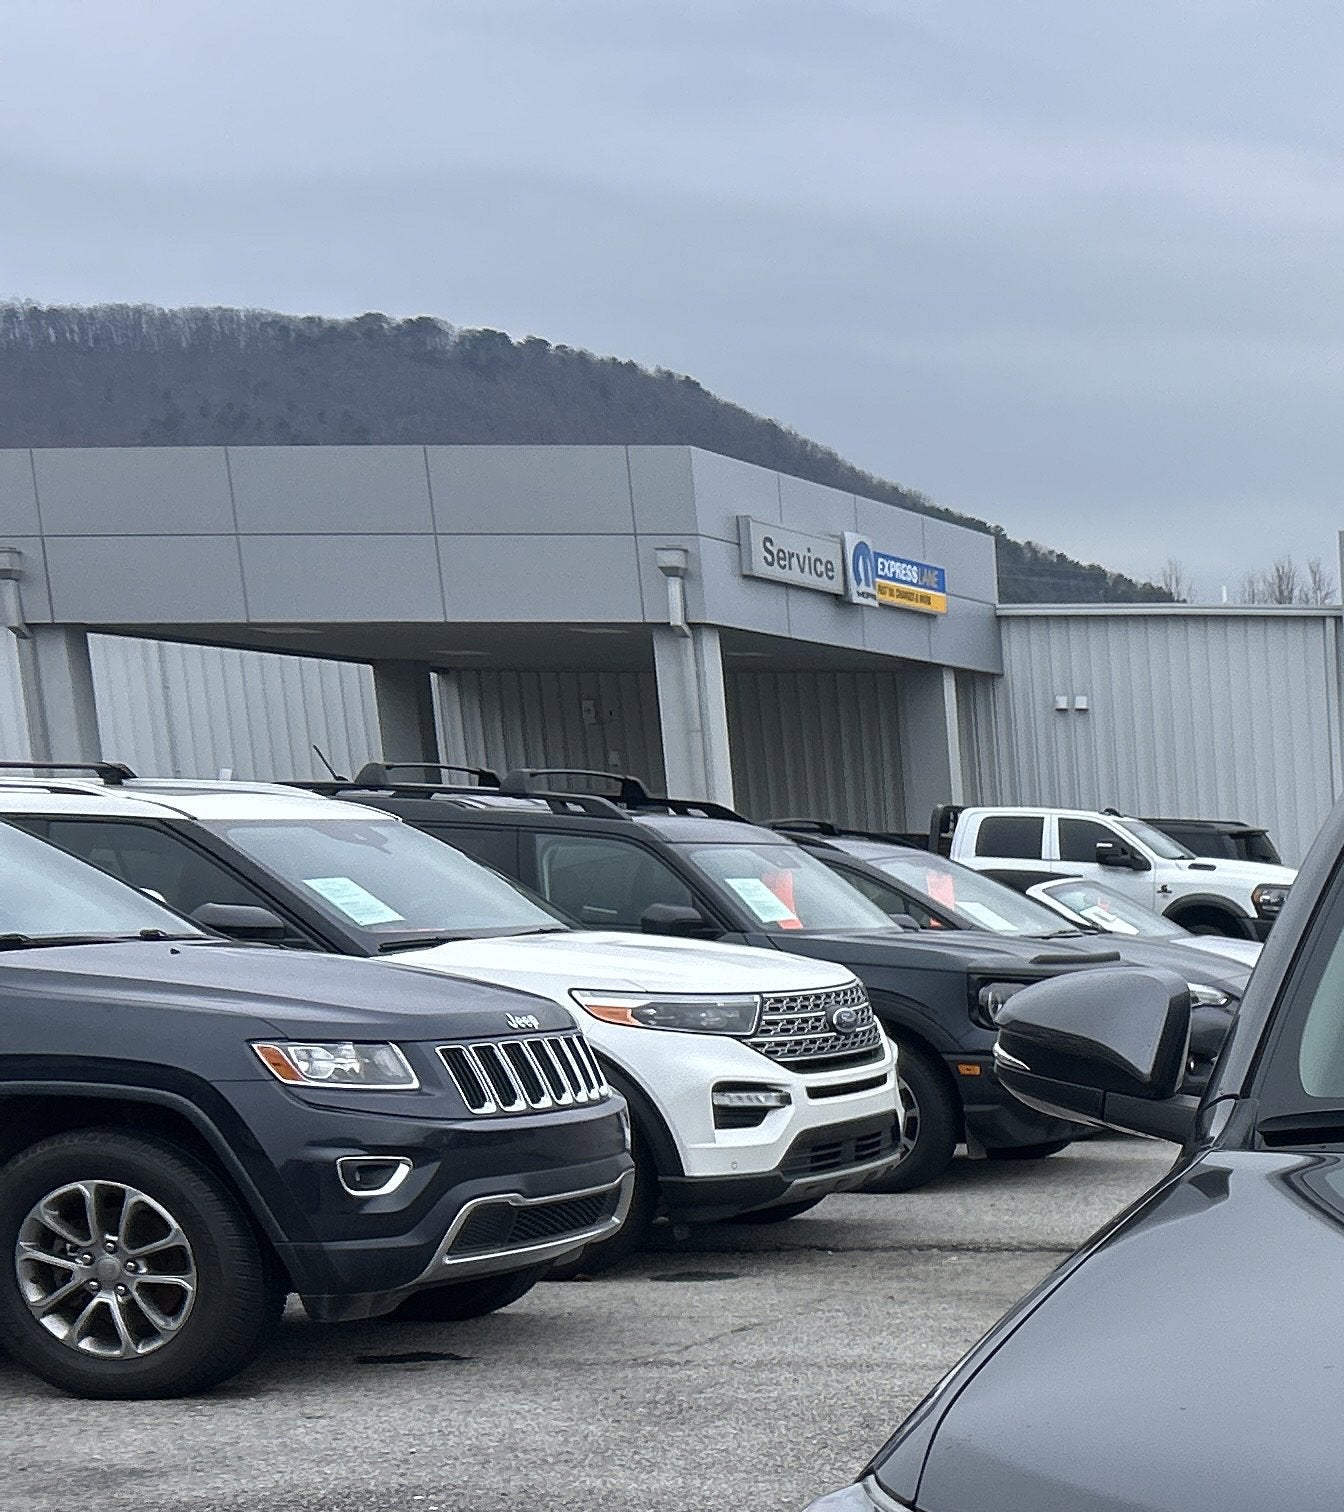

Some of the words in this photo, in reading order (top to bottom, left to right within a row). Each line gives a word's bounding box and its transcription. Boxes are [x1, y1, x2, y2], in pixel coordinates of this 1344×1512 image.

[763, 536, 835, 581] Service
[877, 557, 919, 584] EXPRESS
[505, 1013, 539, 1029] Jeep
